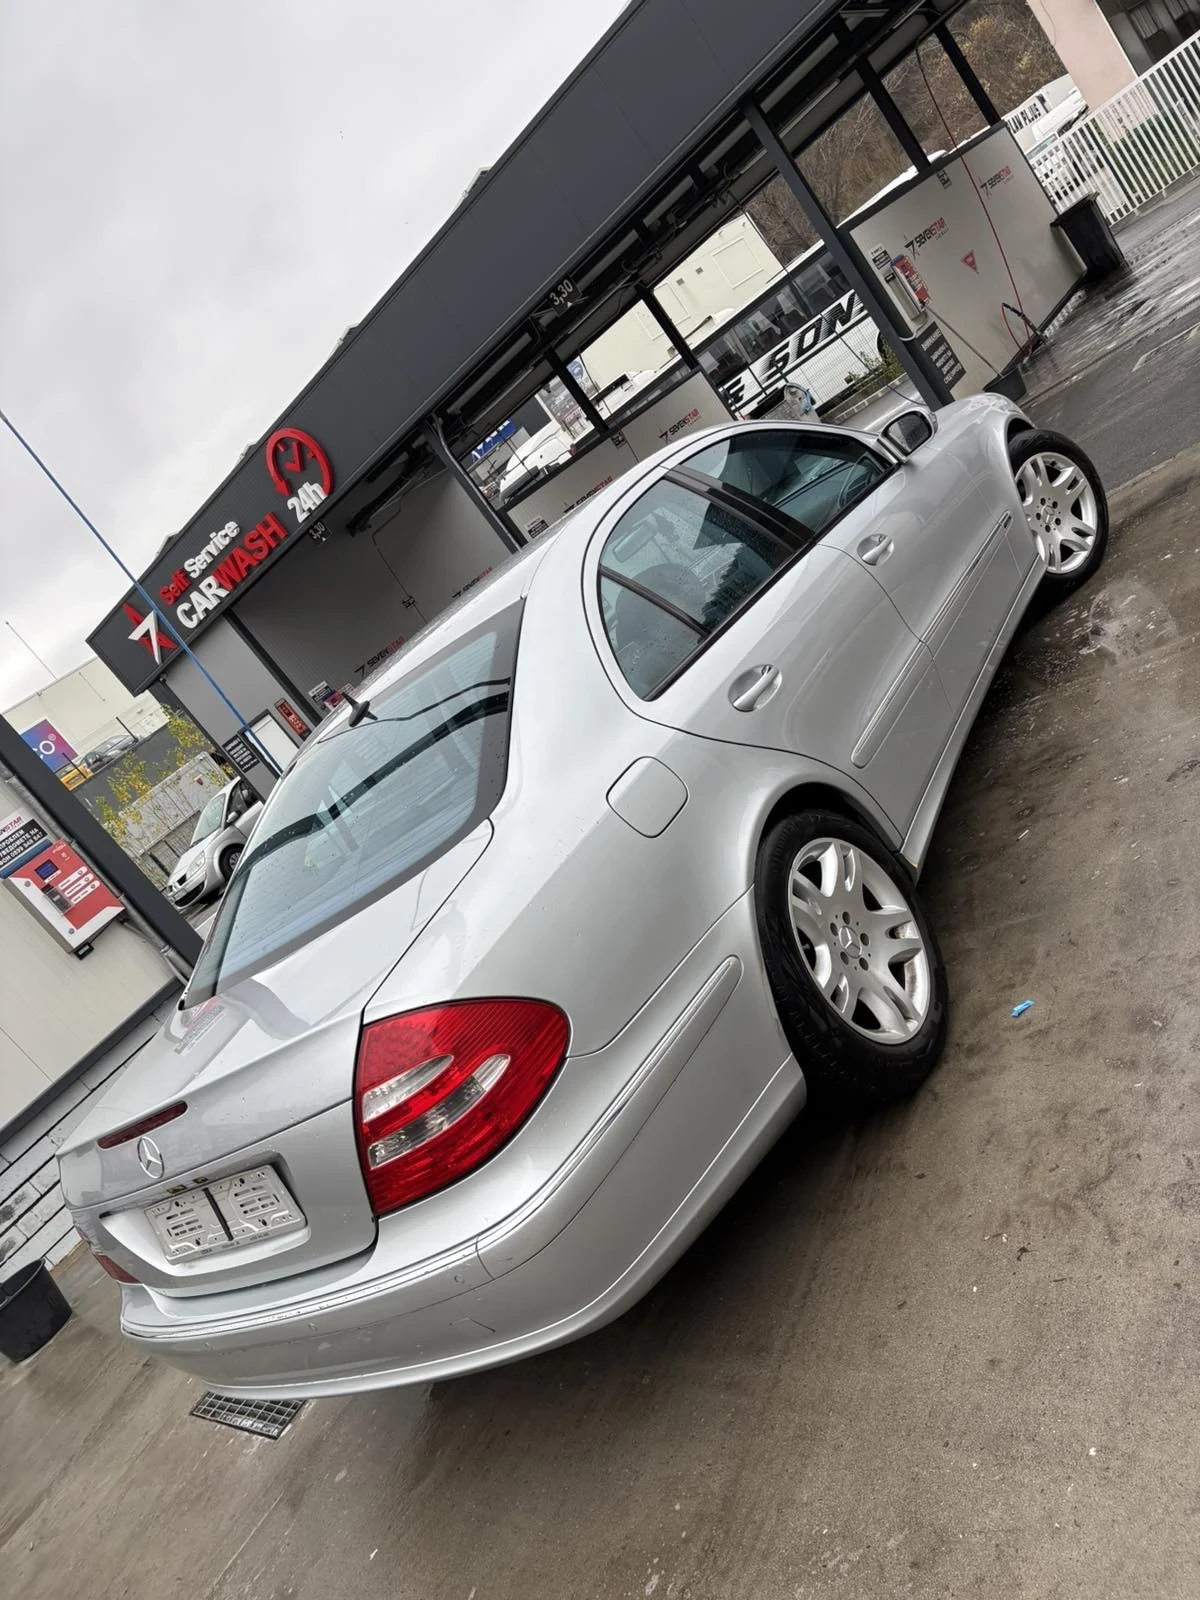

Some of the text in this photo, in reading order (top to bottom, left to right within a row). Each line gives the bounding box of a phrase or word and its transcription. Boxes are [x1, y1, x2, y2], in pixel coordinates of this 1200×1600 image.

[914, 217, 946, 248] SEVENSTAR
[549, 278, 574, 307] 3,30
[669, 408, 701, 436] SEVENSTAR
[287, 481, 329, 523] 24h
[308, 521, 326, 543] 3,30
[159, 520, 241, 606] Self Service
[29, 827, 39, 836] НА
